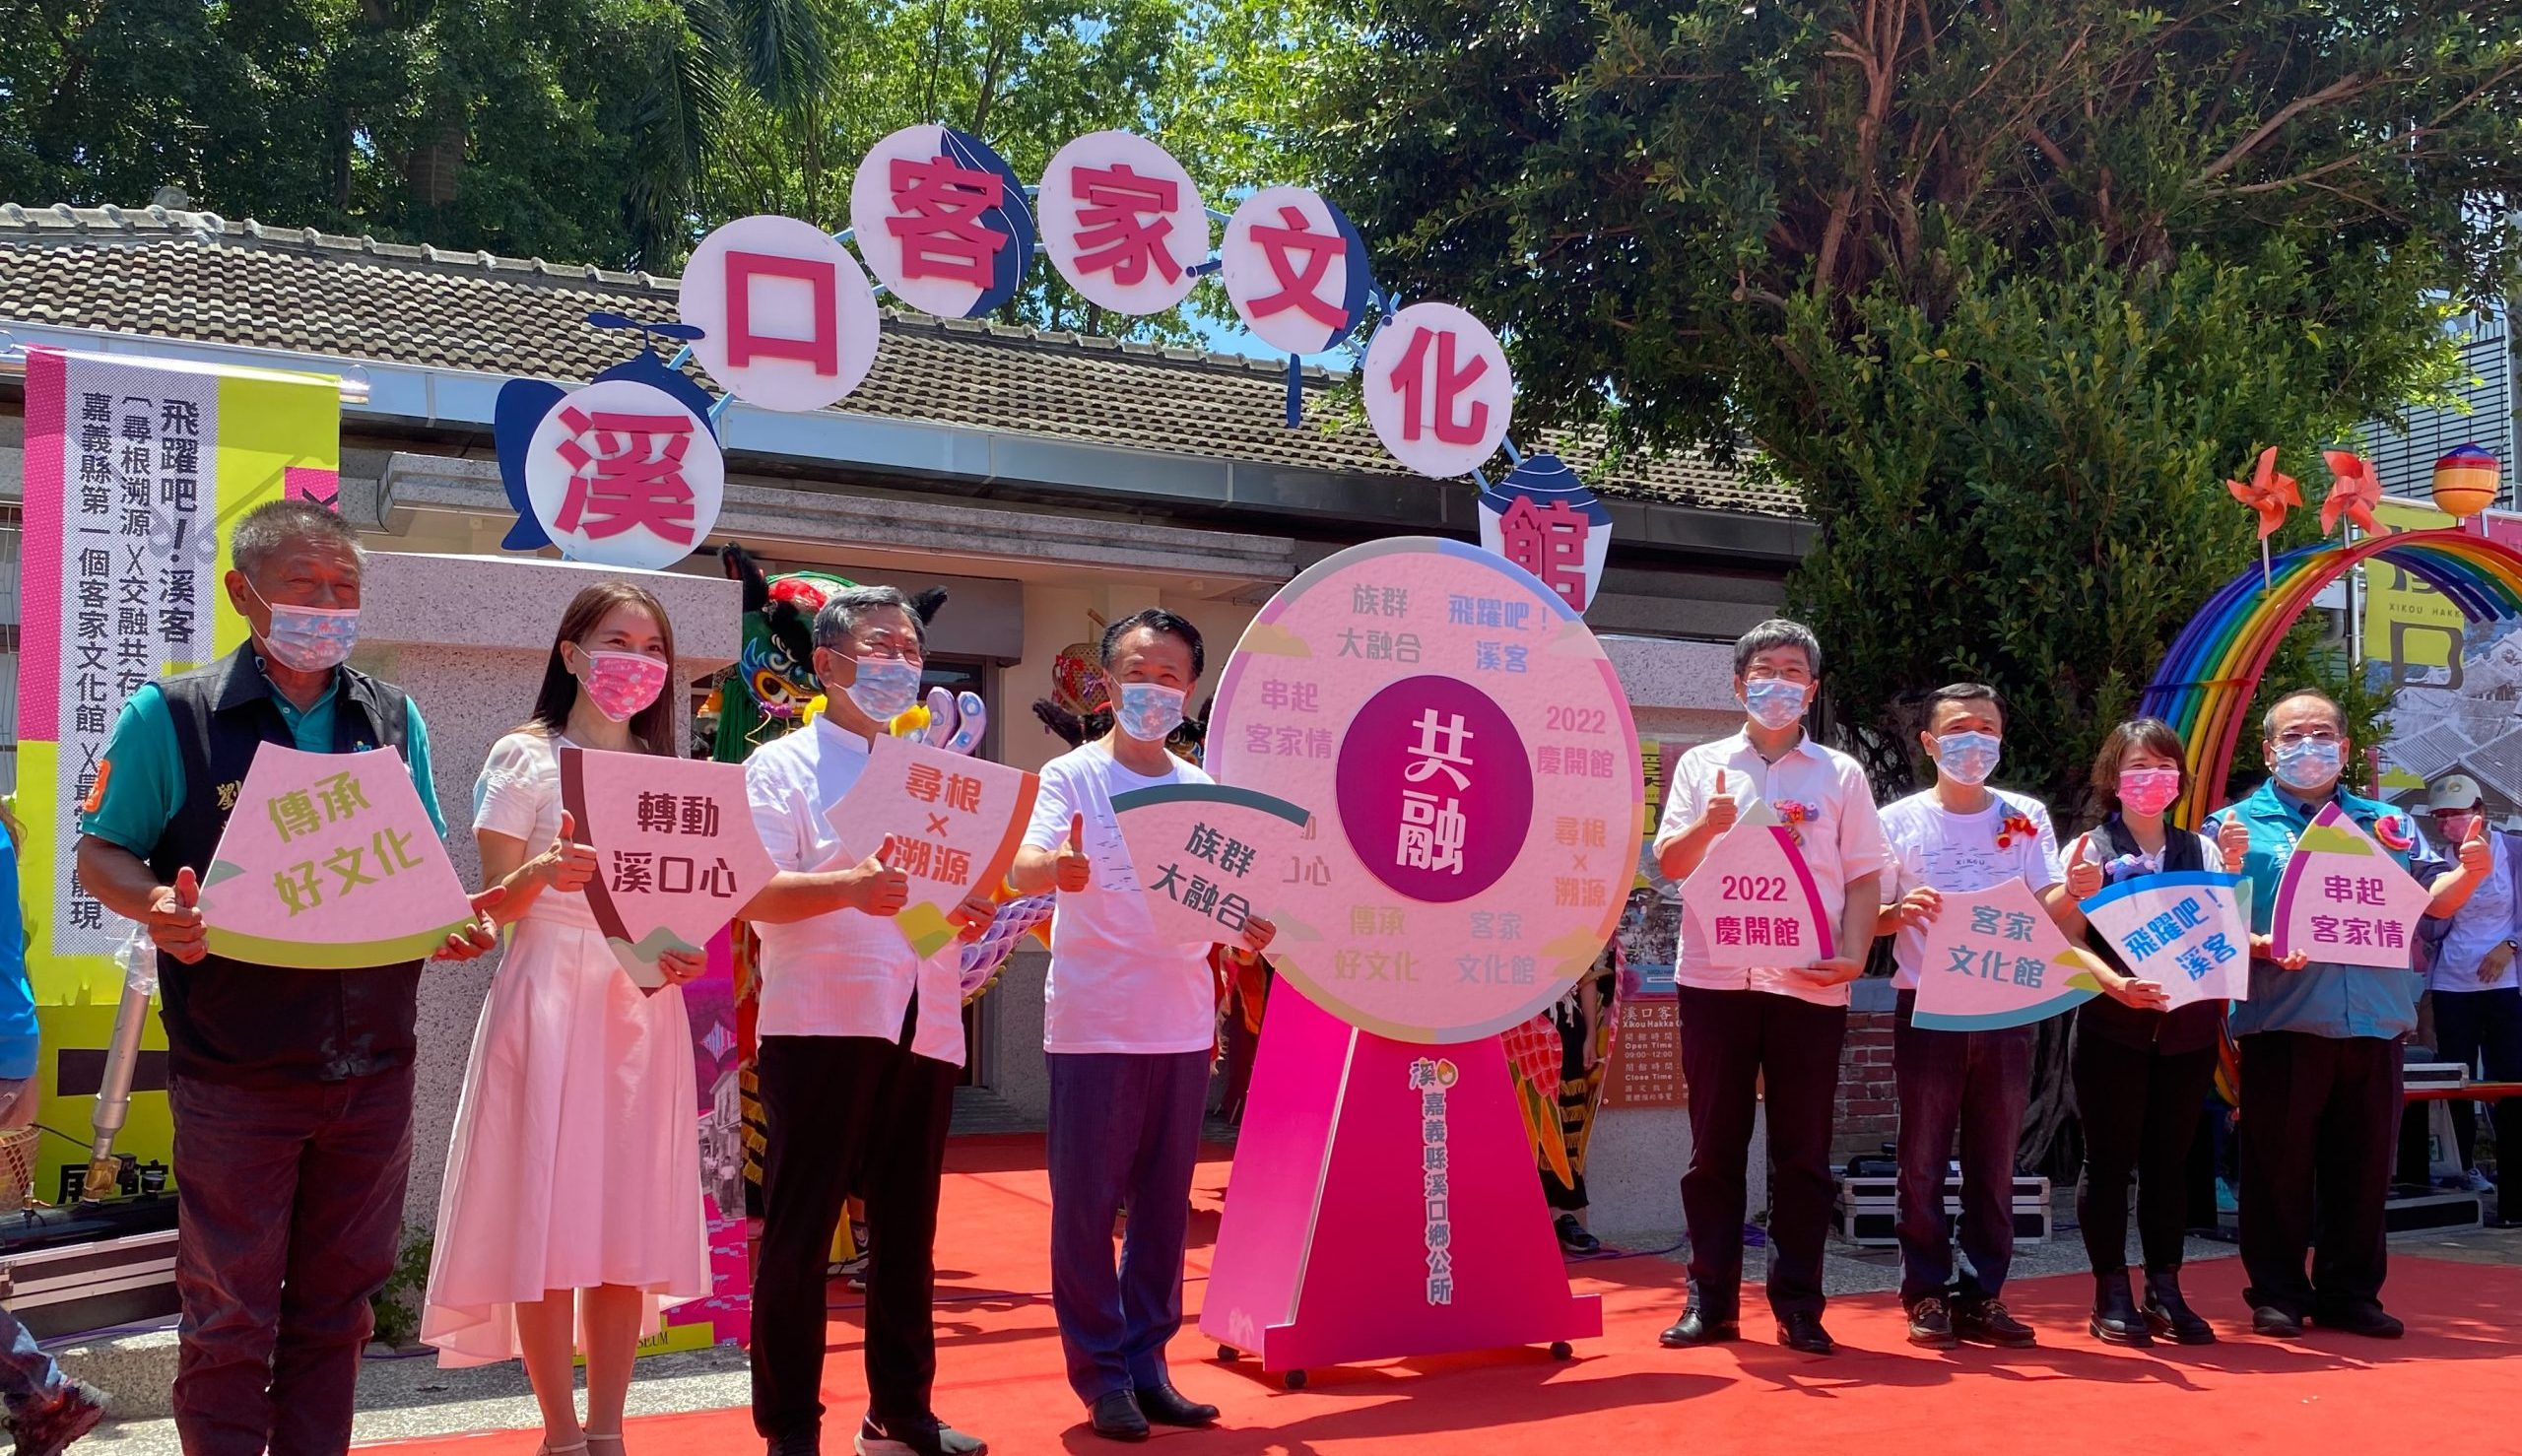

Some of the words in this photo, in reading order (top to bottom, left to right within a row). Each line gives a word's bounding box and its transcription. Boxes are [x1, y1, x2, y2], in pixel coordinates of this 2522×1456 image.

[1353, 583, 1408, 619] 族群
[2432, 606, 2461, 620] HAKK
[1337, 627, 1422, 663] 大融合
[1475, 640, 1528, 673] 溪客
[1261, 679, 1319, 713] 串起
[1546, 705, 1606, 735] 2022
[1245, 724, 1333, 760] 客家情
[1537, 746, 1615, 778] 慶開館
[905, 762, 982, 814] 尋根
[1396, 708, 1475, 875] 共融
[267, 771, 372, 843] 傳承
[636, 791, 720, 837] 轉動
[1555, 816, 1607, 848] 尋根
[893, 834, 971, 886] 溯源
[1184, 822, 1257, 879] 族群
[273, 827, 424, 917] 好文化
[611, 850, 738, 898] 溪口心
[1721, 875, 1789, 902] 2022
[1149, 862, 1251, 932] 大融合
[1555, 877, 1607, 907] 溯源
[2324, 875, 2386, 905] 串起
[1350, 904, 1405, 936] 傳承
[1470, 910, 1522, 940] 客家
[1714, 915, 1801, 948] 慶開館
[1970, 905, 2035, 942] 客家
[2310, 914, 2404, 949] 客家情
[1334, 949, 1420, 982] 好文化
[1456, 954, 1536, 985] 文化館
[1945, 945, 2046, 989] 文化館
[2174, 932, 2238, 982] 溪客
[1425, 1092, 1453, 1303] 嘉義縣溪口鄉公所
[638, 1331, 669, 1348] SEUM
